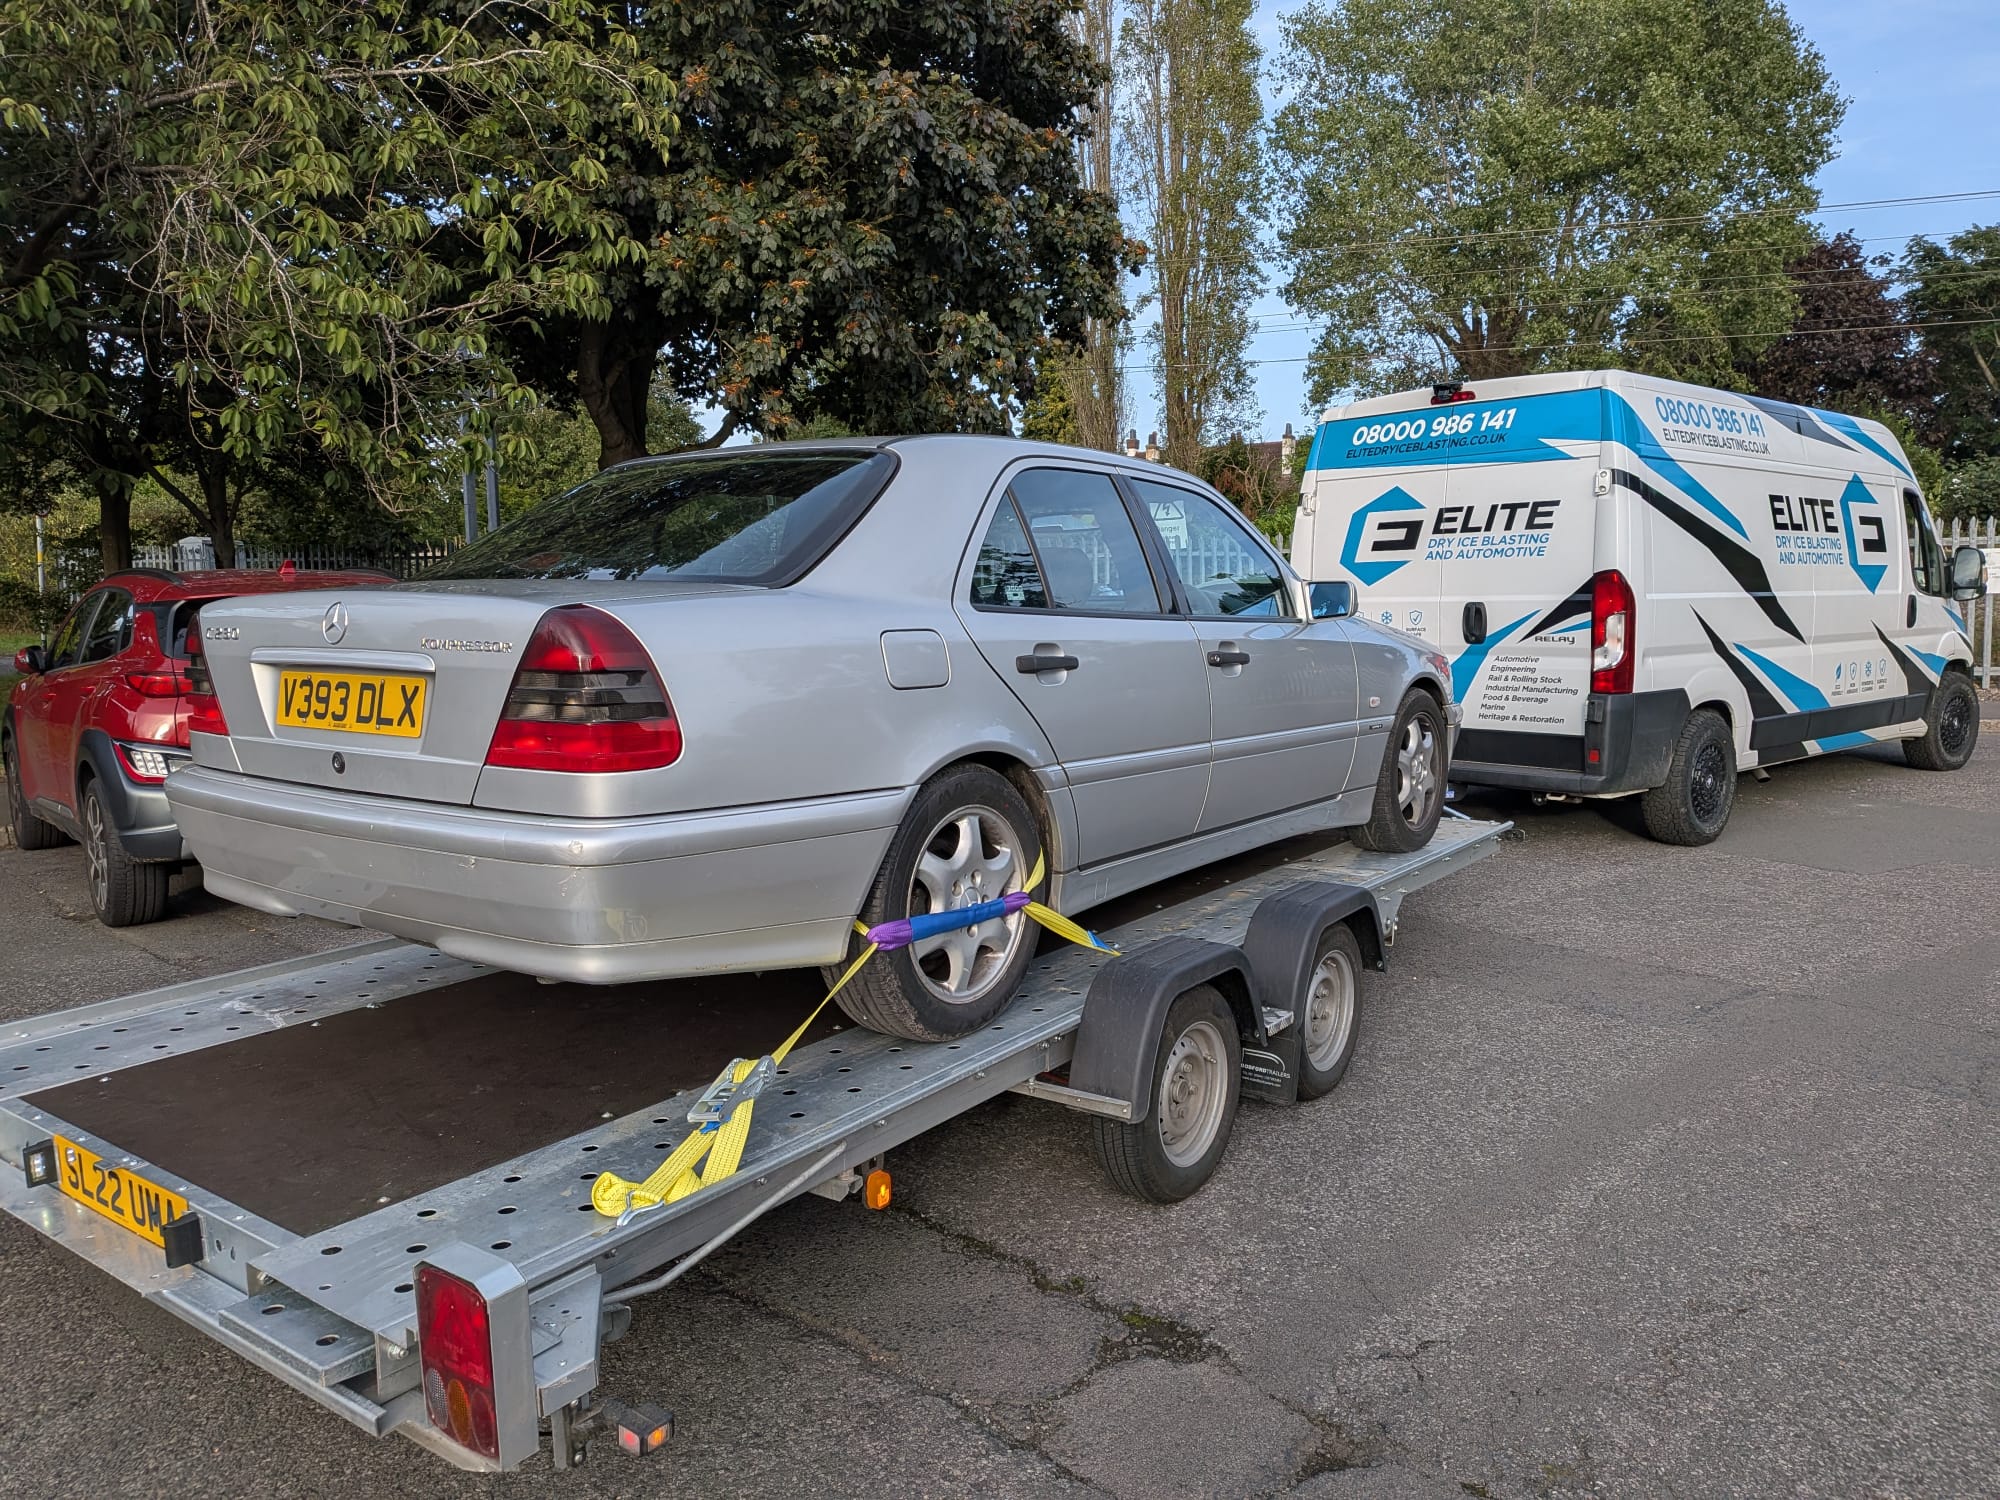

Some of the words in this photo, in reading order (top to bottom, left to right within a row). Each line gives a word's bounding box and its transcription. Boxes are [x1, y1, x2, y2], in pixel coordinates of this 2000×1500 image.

[1655, 396, 1712, 429] 08000
[1712, 406, 1742, 434] 986
[1741, 412, 1766, 438] 141
[1352, 419, 1426, 446] 08000
[1430, 413, 1475, 437] 986
[1480, 407, 1517, 431] 141
[1346, 433, 1508, 459] ELITEDRYICEBLASTING.CO.UK
[1662, 428, 1771, 455] ELITEDRYICEBLASTING.CO.UK
[1432, 500, 1561, 534] ELITE
[1768, 494, 1839, 533] ELITE
[1428, 538, 1455, 549] DRY
[1457, 536, 1479, 547] ICE
[1481, 533, 1550, 546] BLASTING
[1776, 535, 1791, 548] DRY
[1793, 536, 1806, 549] ICE
[1807, 536, 1842, 550] BLASTING
[1425, 550, 1453, 560] AND
[1455, 546, 1547, 560] AUTOMOTIVE
[1779, 551, 1795, 564] AND
[1797, 552, 1844, 565] AUTOMOTIVE
[421, 638, 512, 653] KOMPRESSOR
[1534, 636, 1575, 645] RELAY
[1494, 655, 1540, 663] Automotive
[1490, 664, 1537, 674] Engineering
[1487, 674, 1503, 682] Rail
[1511, 675, 1538, 684] Rolling
[1539, 676, 1563, 684] Stock
[1485, 684, 1520, 692] Industrial
[1522, 685, 1579, 695] Manufacturing
[283, 677, 351, 723] V393
[355, 681, 420, 728] DLX
[1482, 693, 1503, 701] Food
[1511, 695, 1549, 704] Beverage
[1480, 703, 1506, 711] Marine
[1478, 712, 1510, 722] Heritage
[1519, 714, 1565, 724] Restoration
[65, 1147, 125, 1217] SL22
